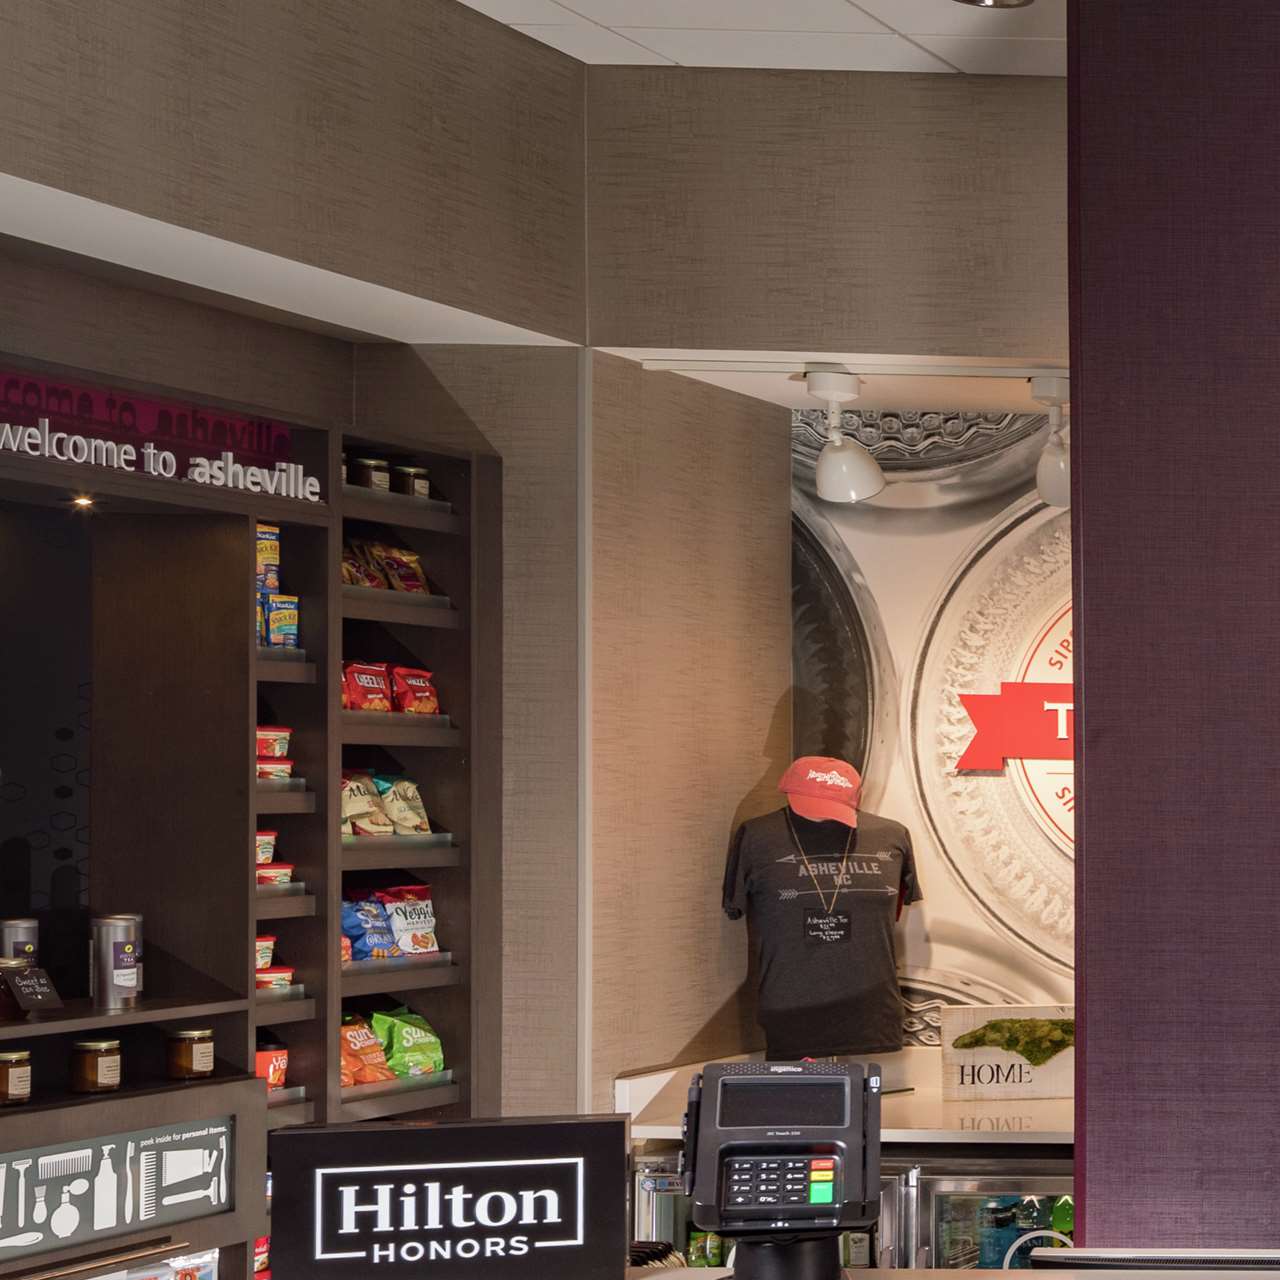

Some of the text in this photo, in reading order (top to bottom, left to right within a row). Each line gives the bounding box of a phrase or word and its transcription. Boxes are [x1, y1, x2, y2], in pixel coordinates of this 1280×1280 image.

[0, 418, 321, 502] welcome to asheville
[798, 861, 882, 877] ASHEVILLE
[833, 874, 852, 886] NC
[959, 1063, 1033, 1086] HOME
[173, 1132, 182, 1141] for
[182, 1127, 208, 1141] personal
[338, 1181, 562, 1234] Hilton
[373, 1236, 529, 1263] HONORS
